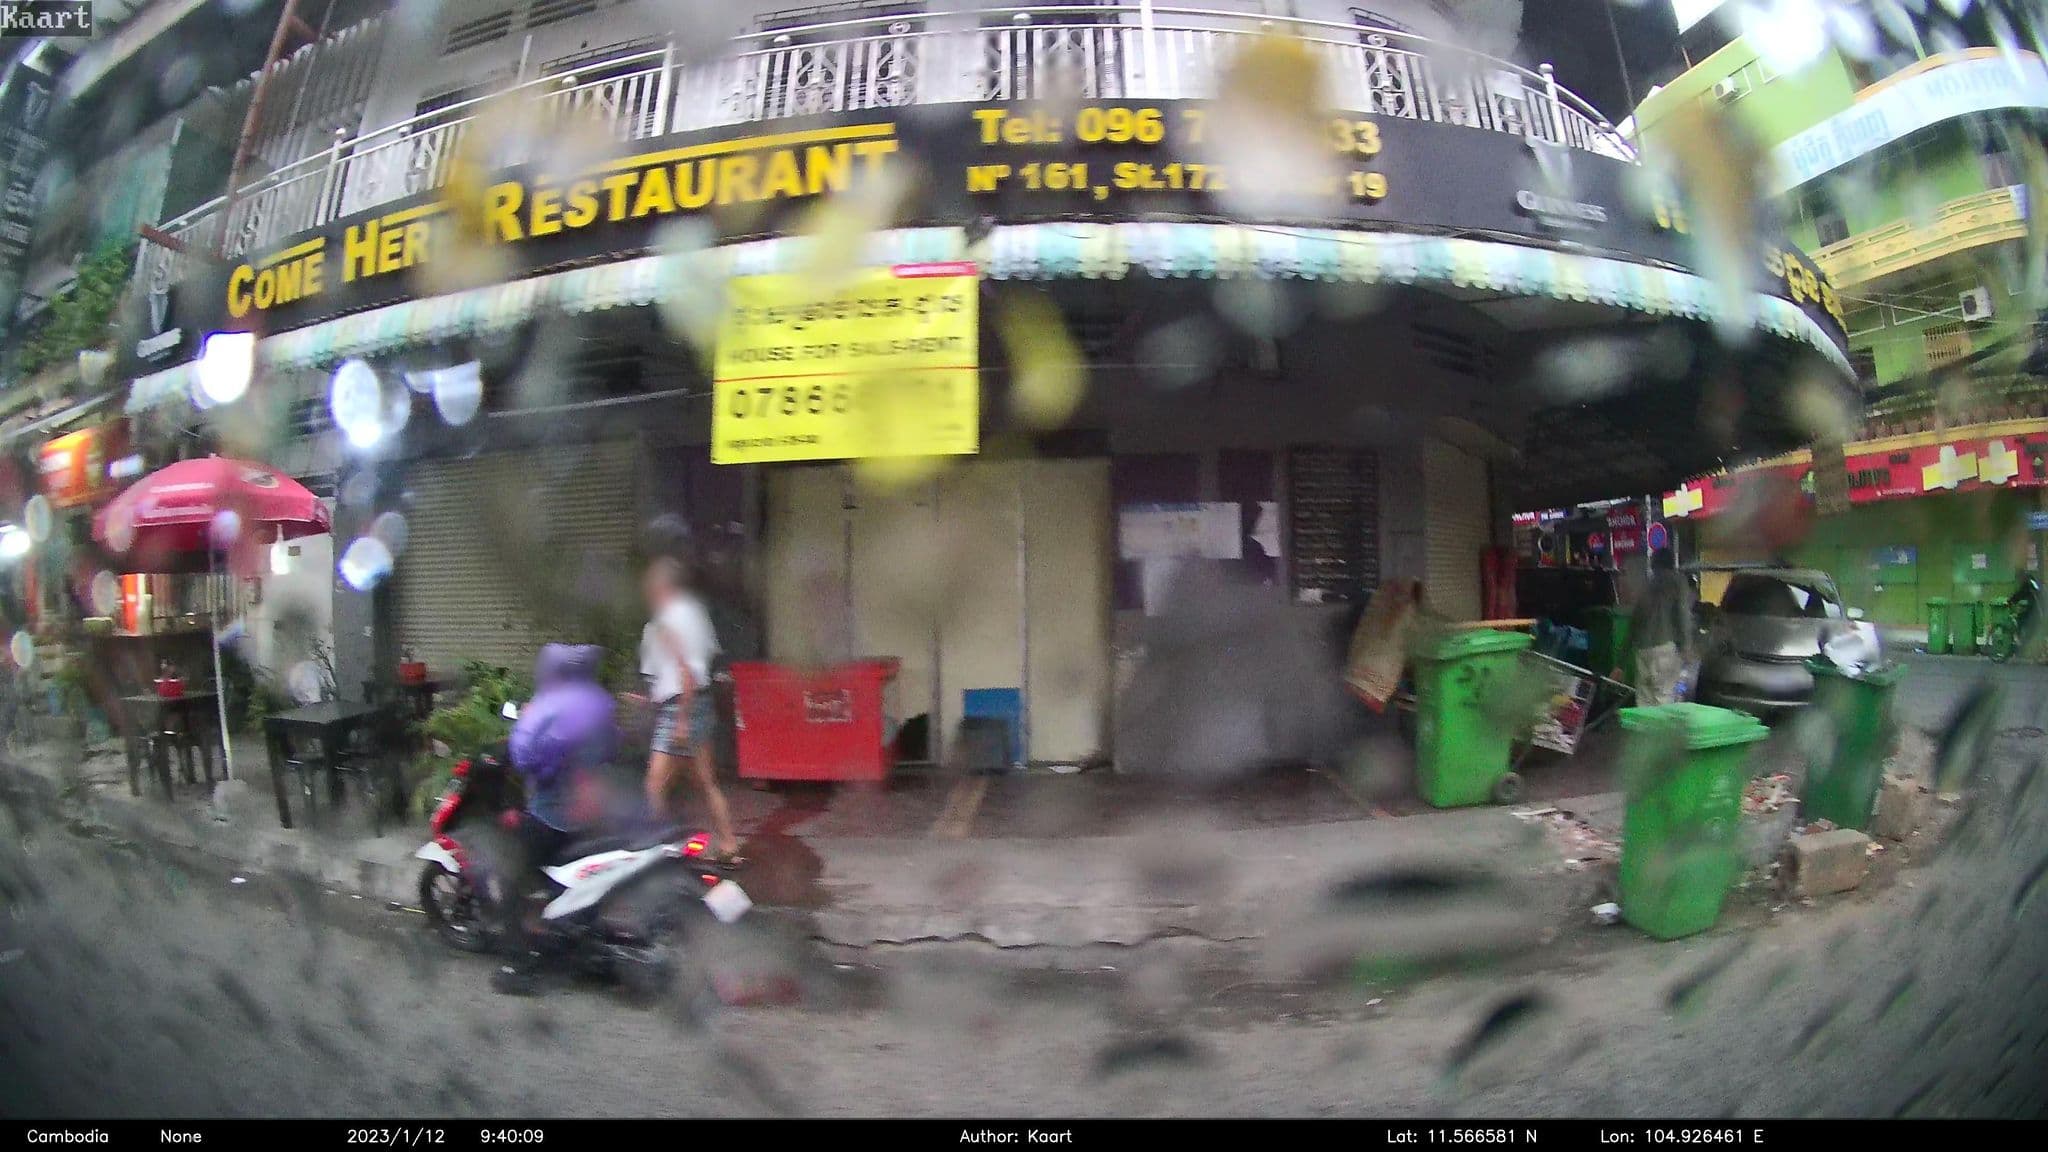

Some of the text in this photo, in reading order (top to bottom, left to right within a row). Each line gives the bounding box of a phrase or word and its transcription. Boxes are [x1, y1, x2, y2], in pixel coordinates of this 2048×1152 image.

[973, 109, 1063, 144] Tel:
[1076, 107, 1165, 145] 096
[227, 140, 898, 318] COME HER RESTAURANT
